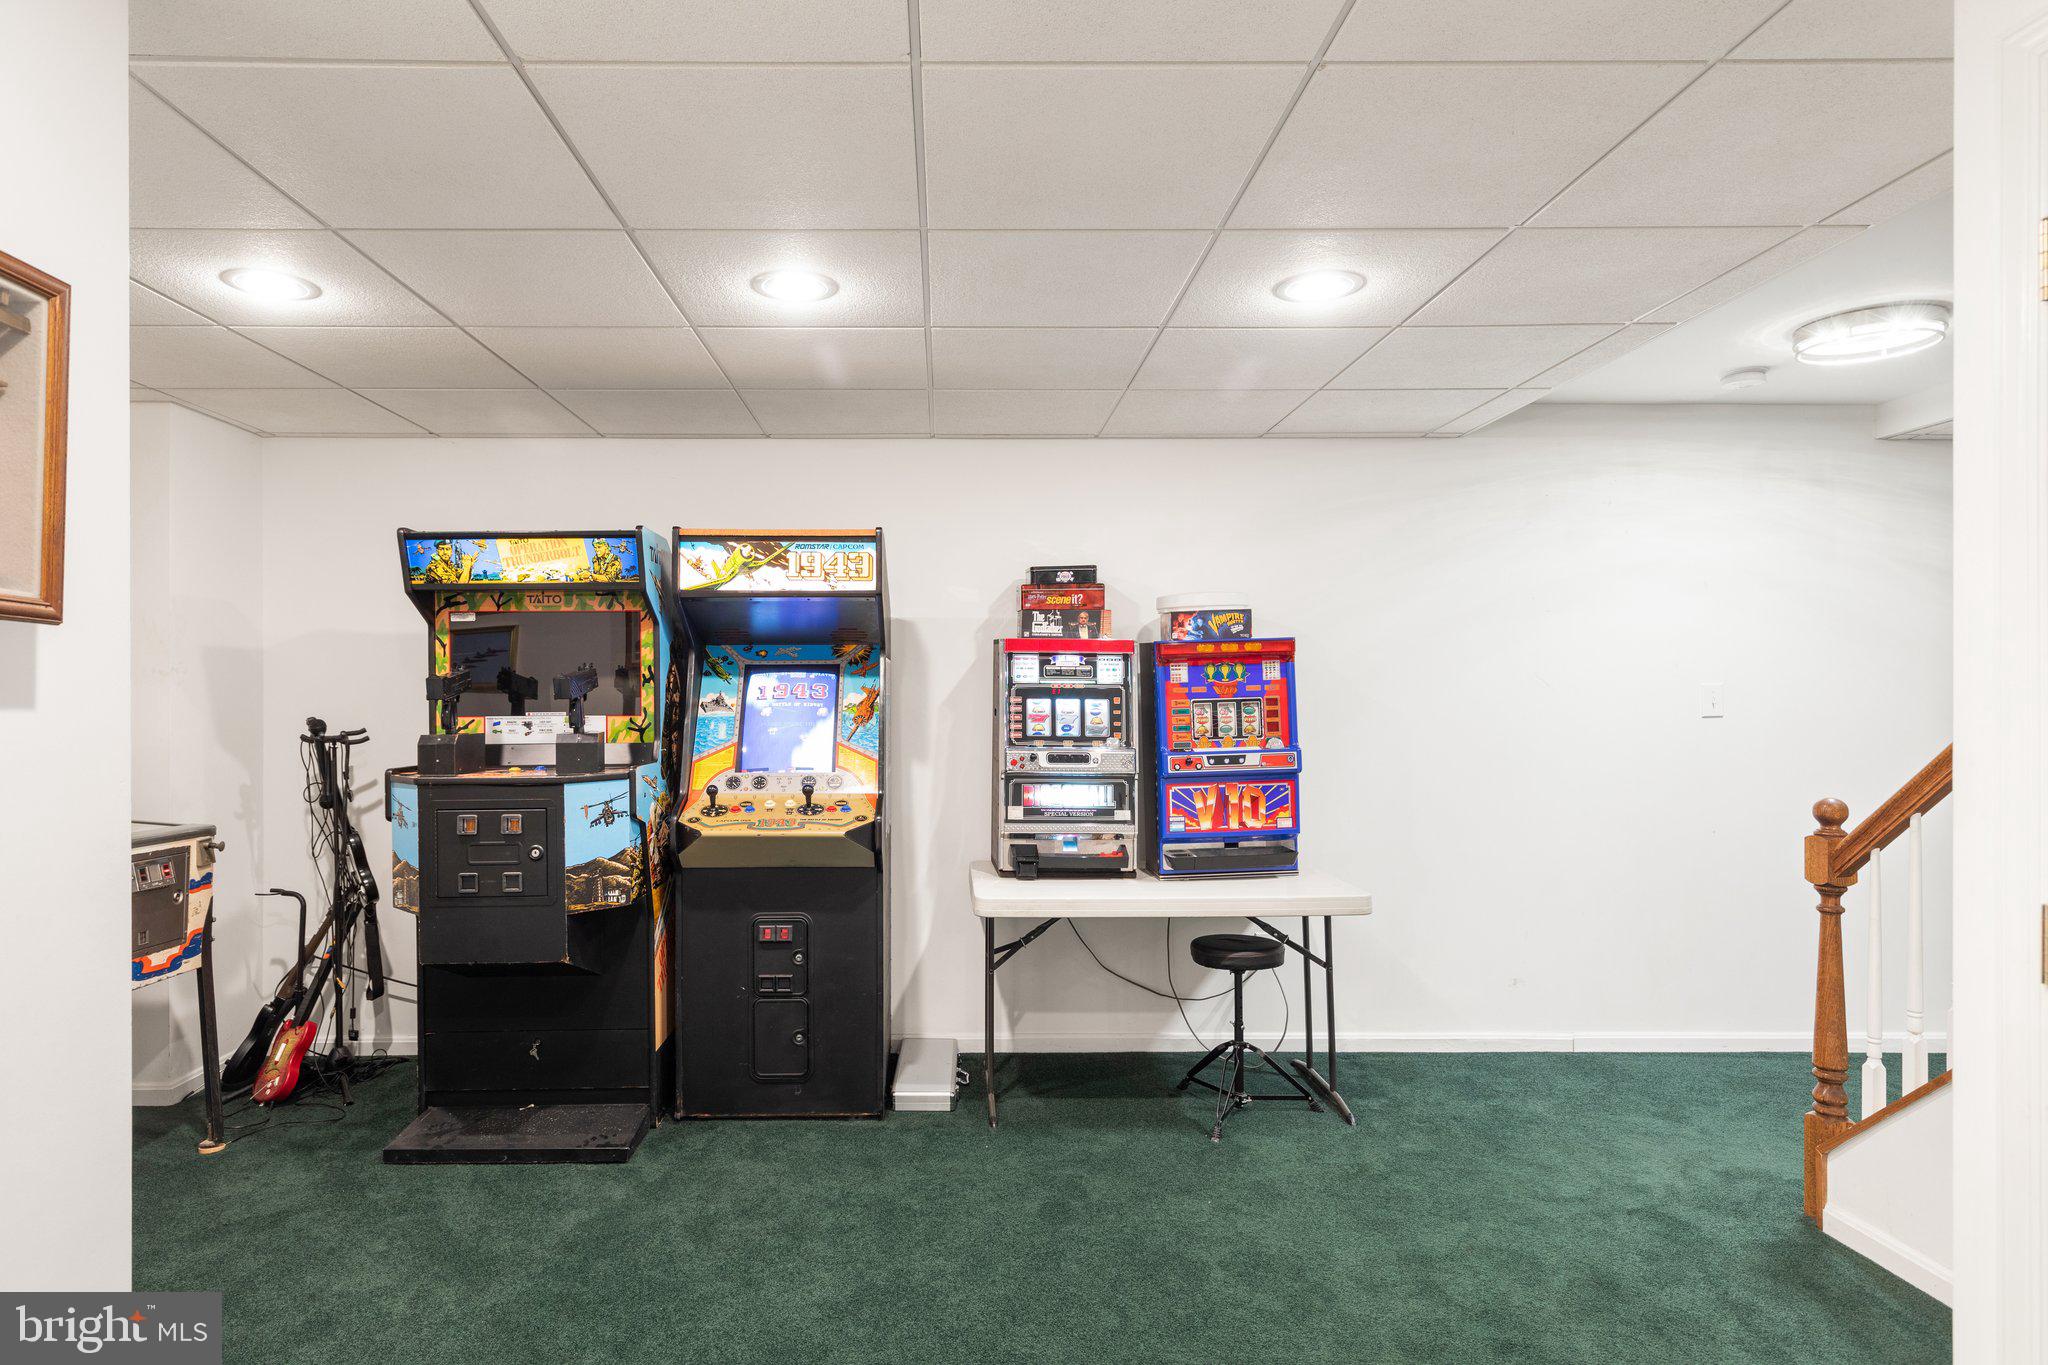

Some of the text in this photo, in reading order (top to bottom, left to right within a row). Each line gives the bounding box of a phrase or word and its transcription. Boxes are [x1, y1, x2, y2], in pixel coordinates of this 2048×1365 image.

[502, 545, 581, 568] THUNDERBOLT
[509, 540, 568, 556] OPERATION
[786, 551, 874, 582] 1943
[526, 592, 562, 604] TAITO
[1046, 595, 1071, 605] scene
[1071, 593, 1083, 605] it?
[1031, 611, 1045, 622] The
[1208, 612, 1244, 637] VAMPIRE
[757, 682, 829, 701] 1943
